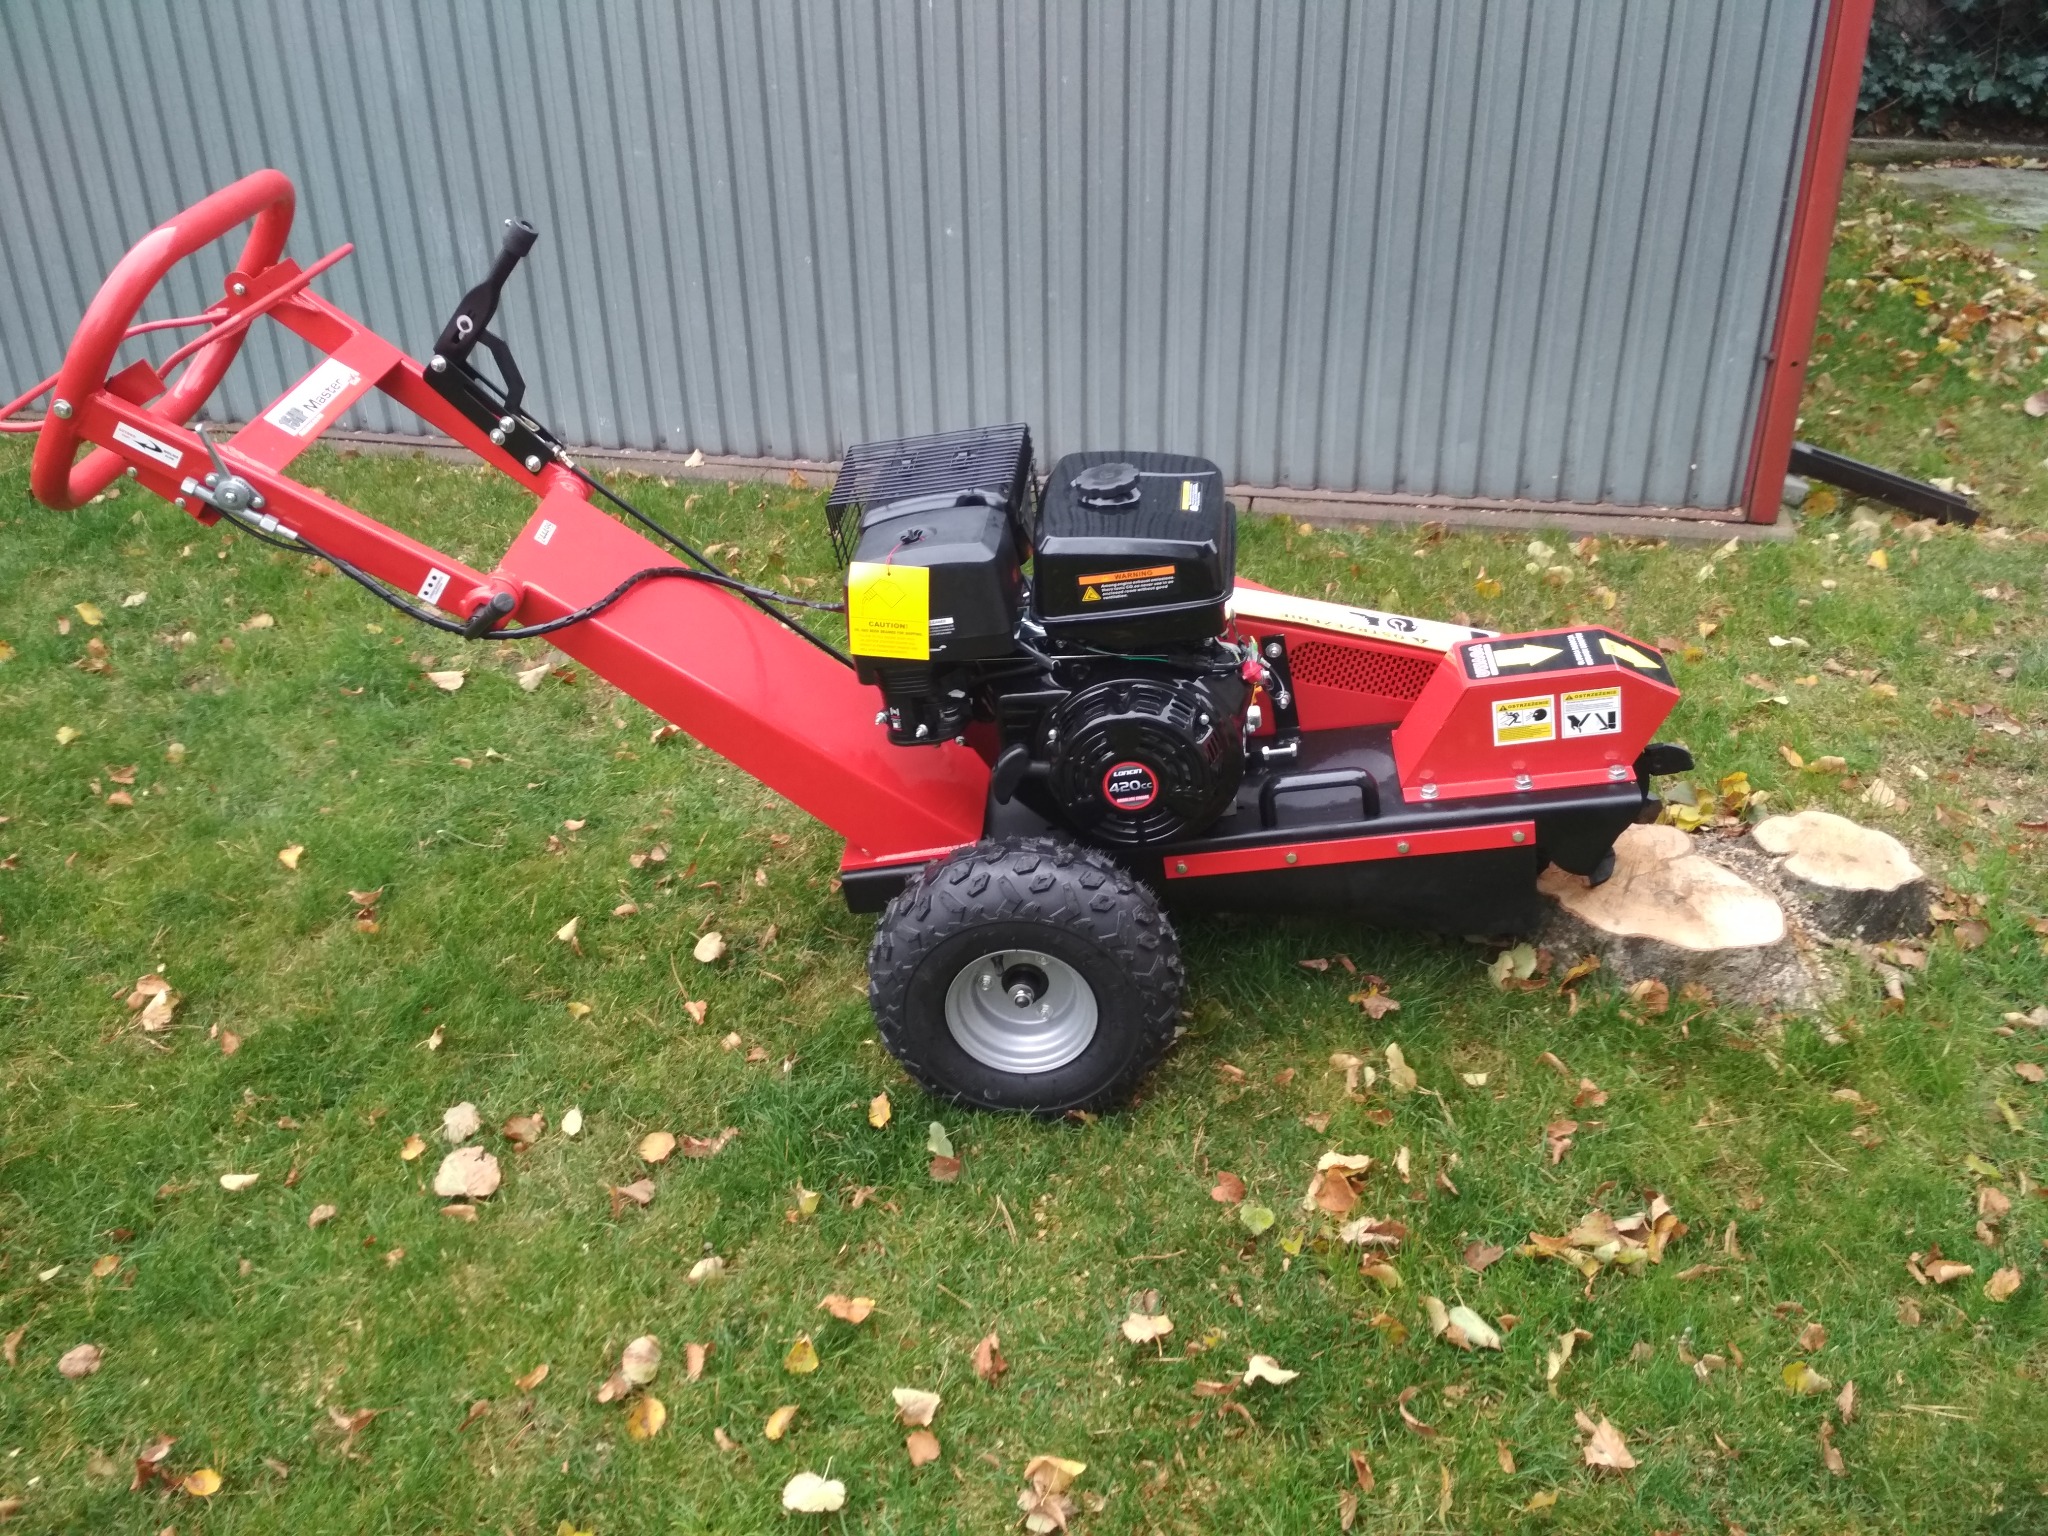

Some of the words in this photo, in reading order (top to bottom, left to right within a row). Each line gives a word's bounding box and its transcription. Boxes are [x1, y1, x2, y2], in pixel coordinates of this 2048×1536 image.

[302, 378, 343, 412] Master
[1114, 569, 1153, 580] WARNING
[868, 621, 909, 630] CAUTION!
